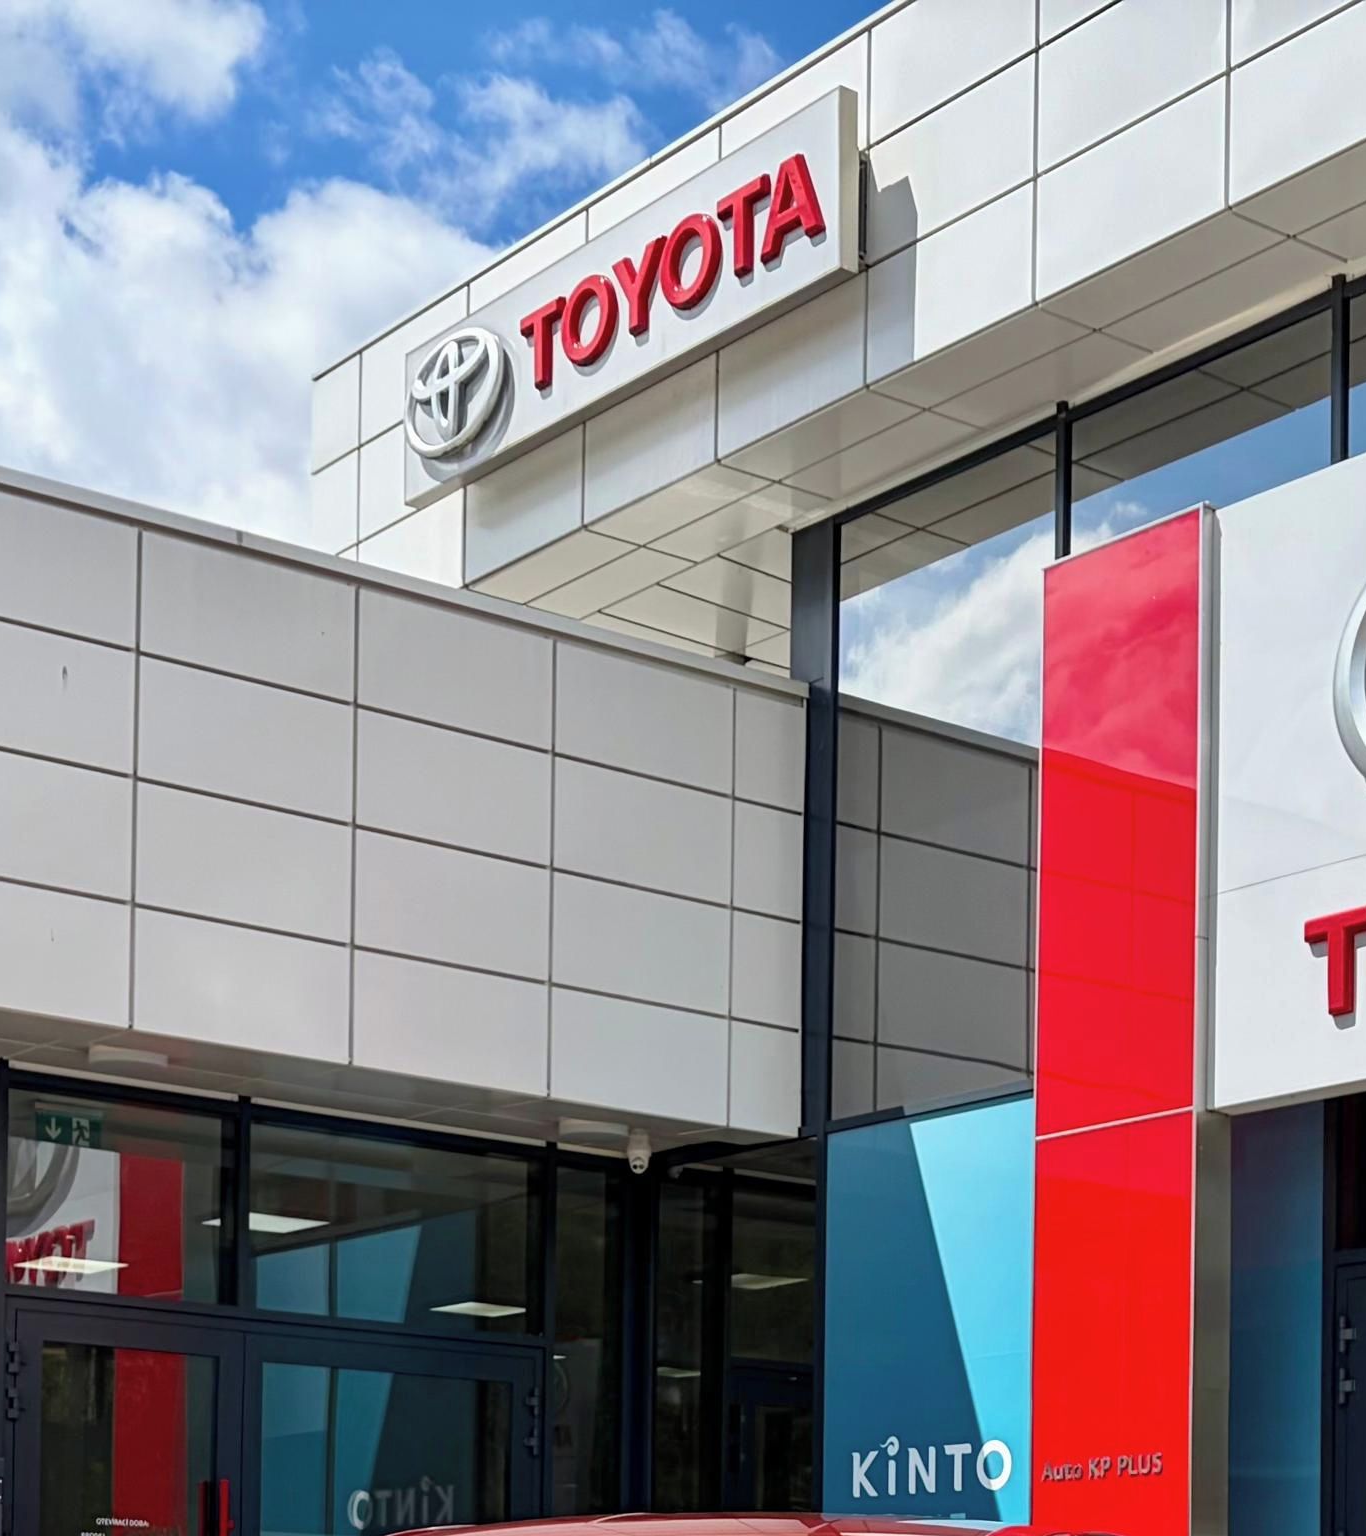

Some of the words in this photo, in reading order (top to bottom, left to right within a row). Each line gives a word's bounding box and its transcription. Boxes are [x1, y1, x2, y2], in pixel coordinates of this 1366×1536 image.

[520, 153, 826, 390] TOYOTA
[1087, 1458, 1112, 1480] KP
[1116, 1452, 1163, 1476] PLUS
